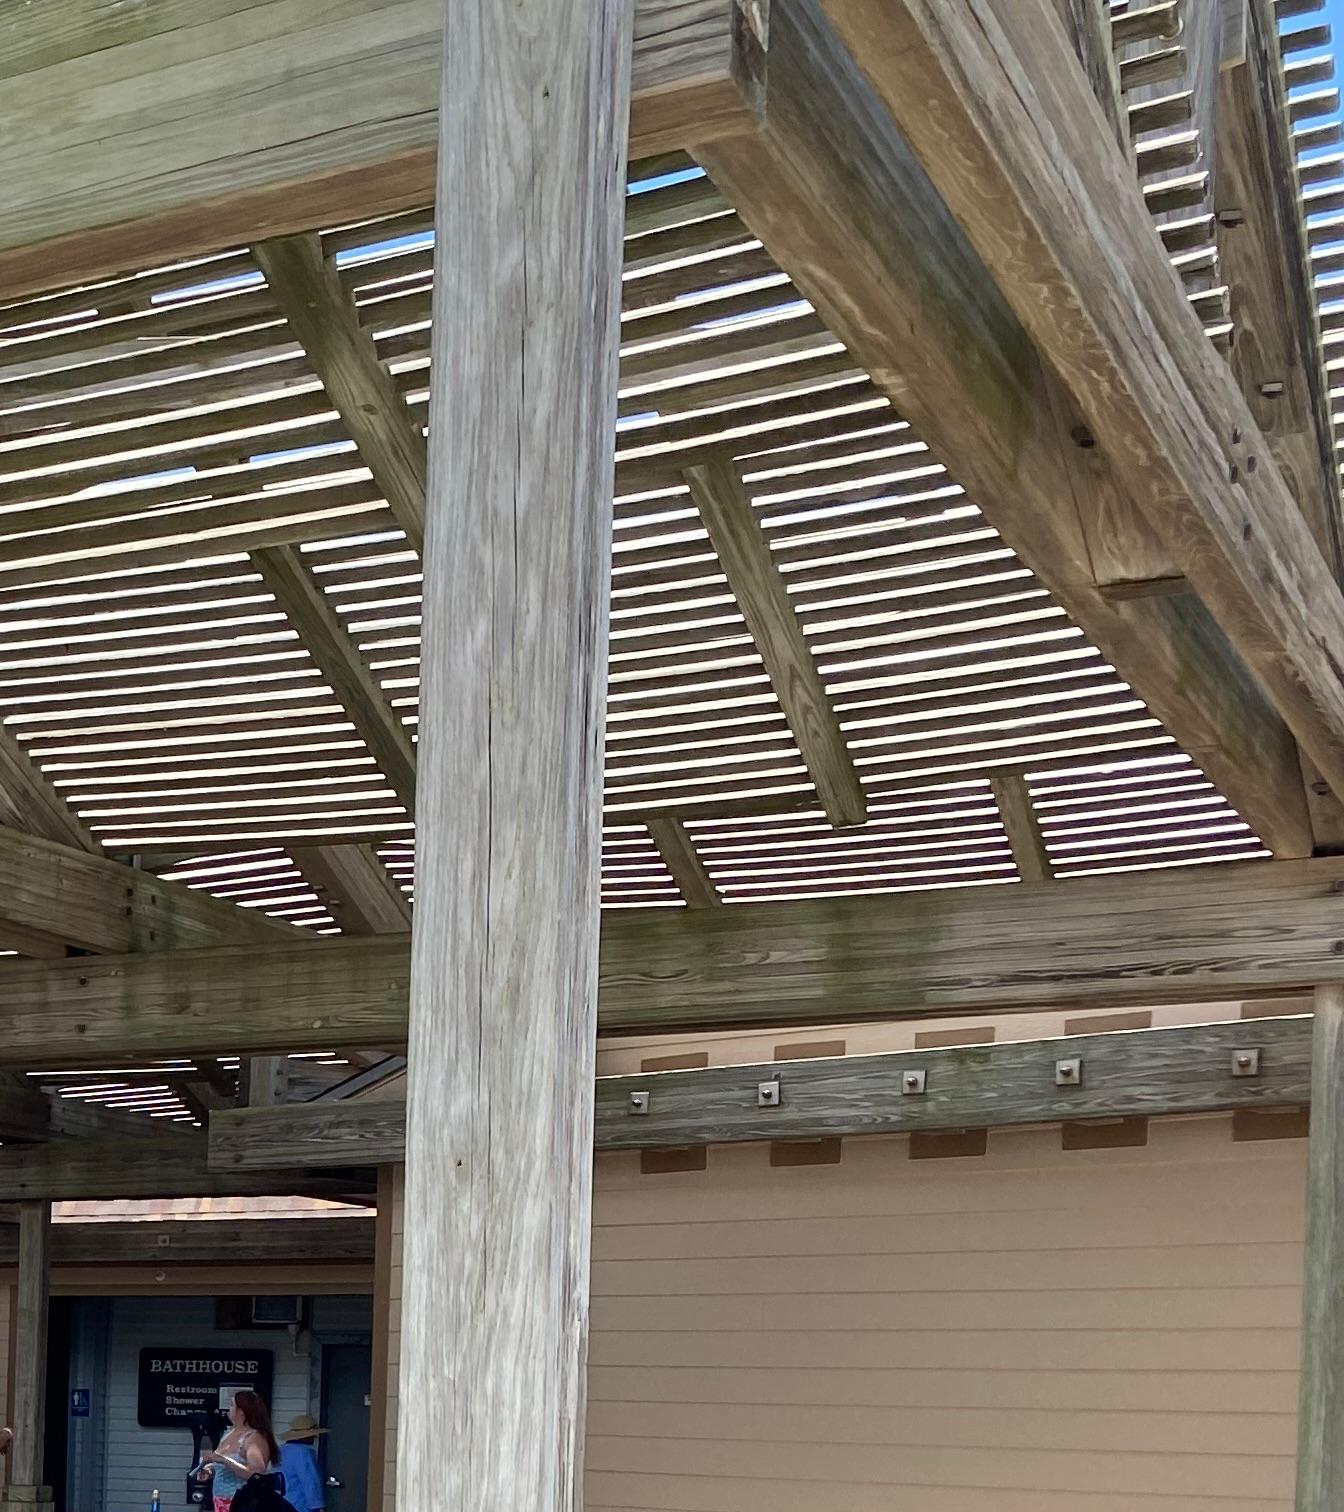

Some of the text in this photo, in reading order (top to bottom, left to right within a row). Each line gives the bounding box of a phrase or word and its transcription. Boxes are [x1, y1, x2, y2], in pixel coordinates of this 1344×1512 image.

[150, 1359, 259, 1374] BATHHOUSE
[166, 1384, 218, 1394] Restroom
[165, 1395, 206, 1405] Shower
